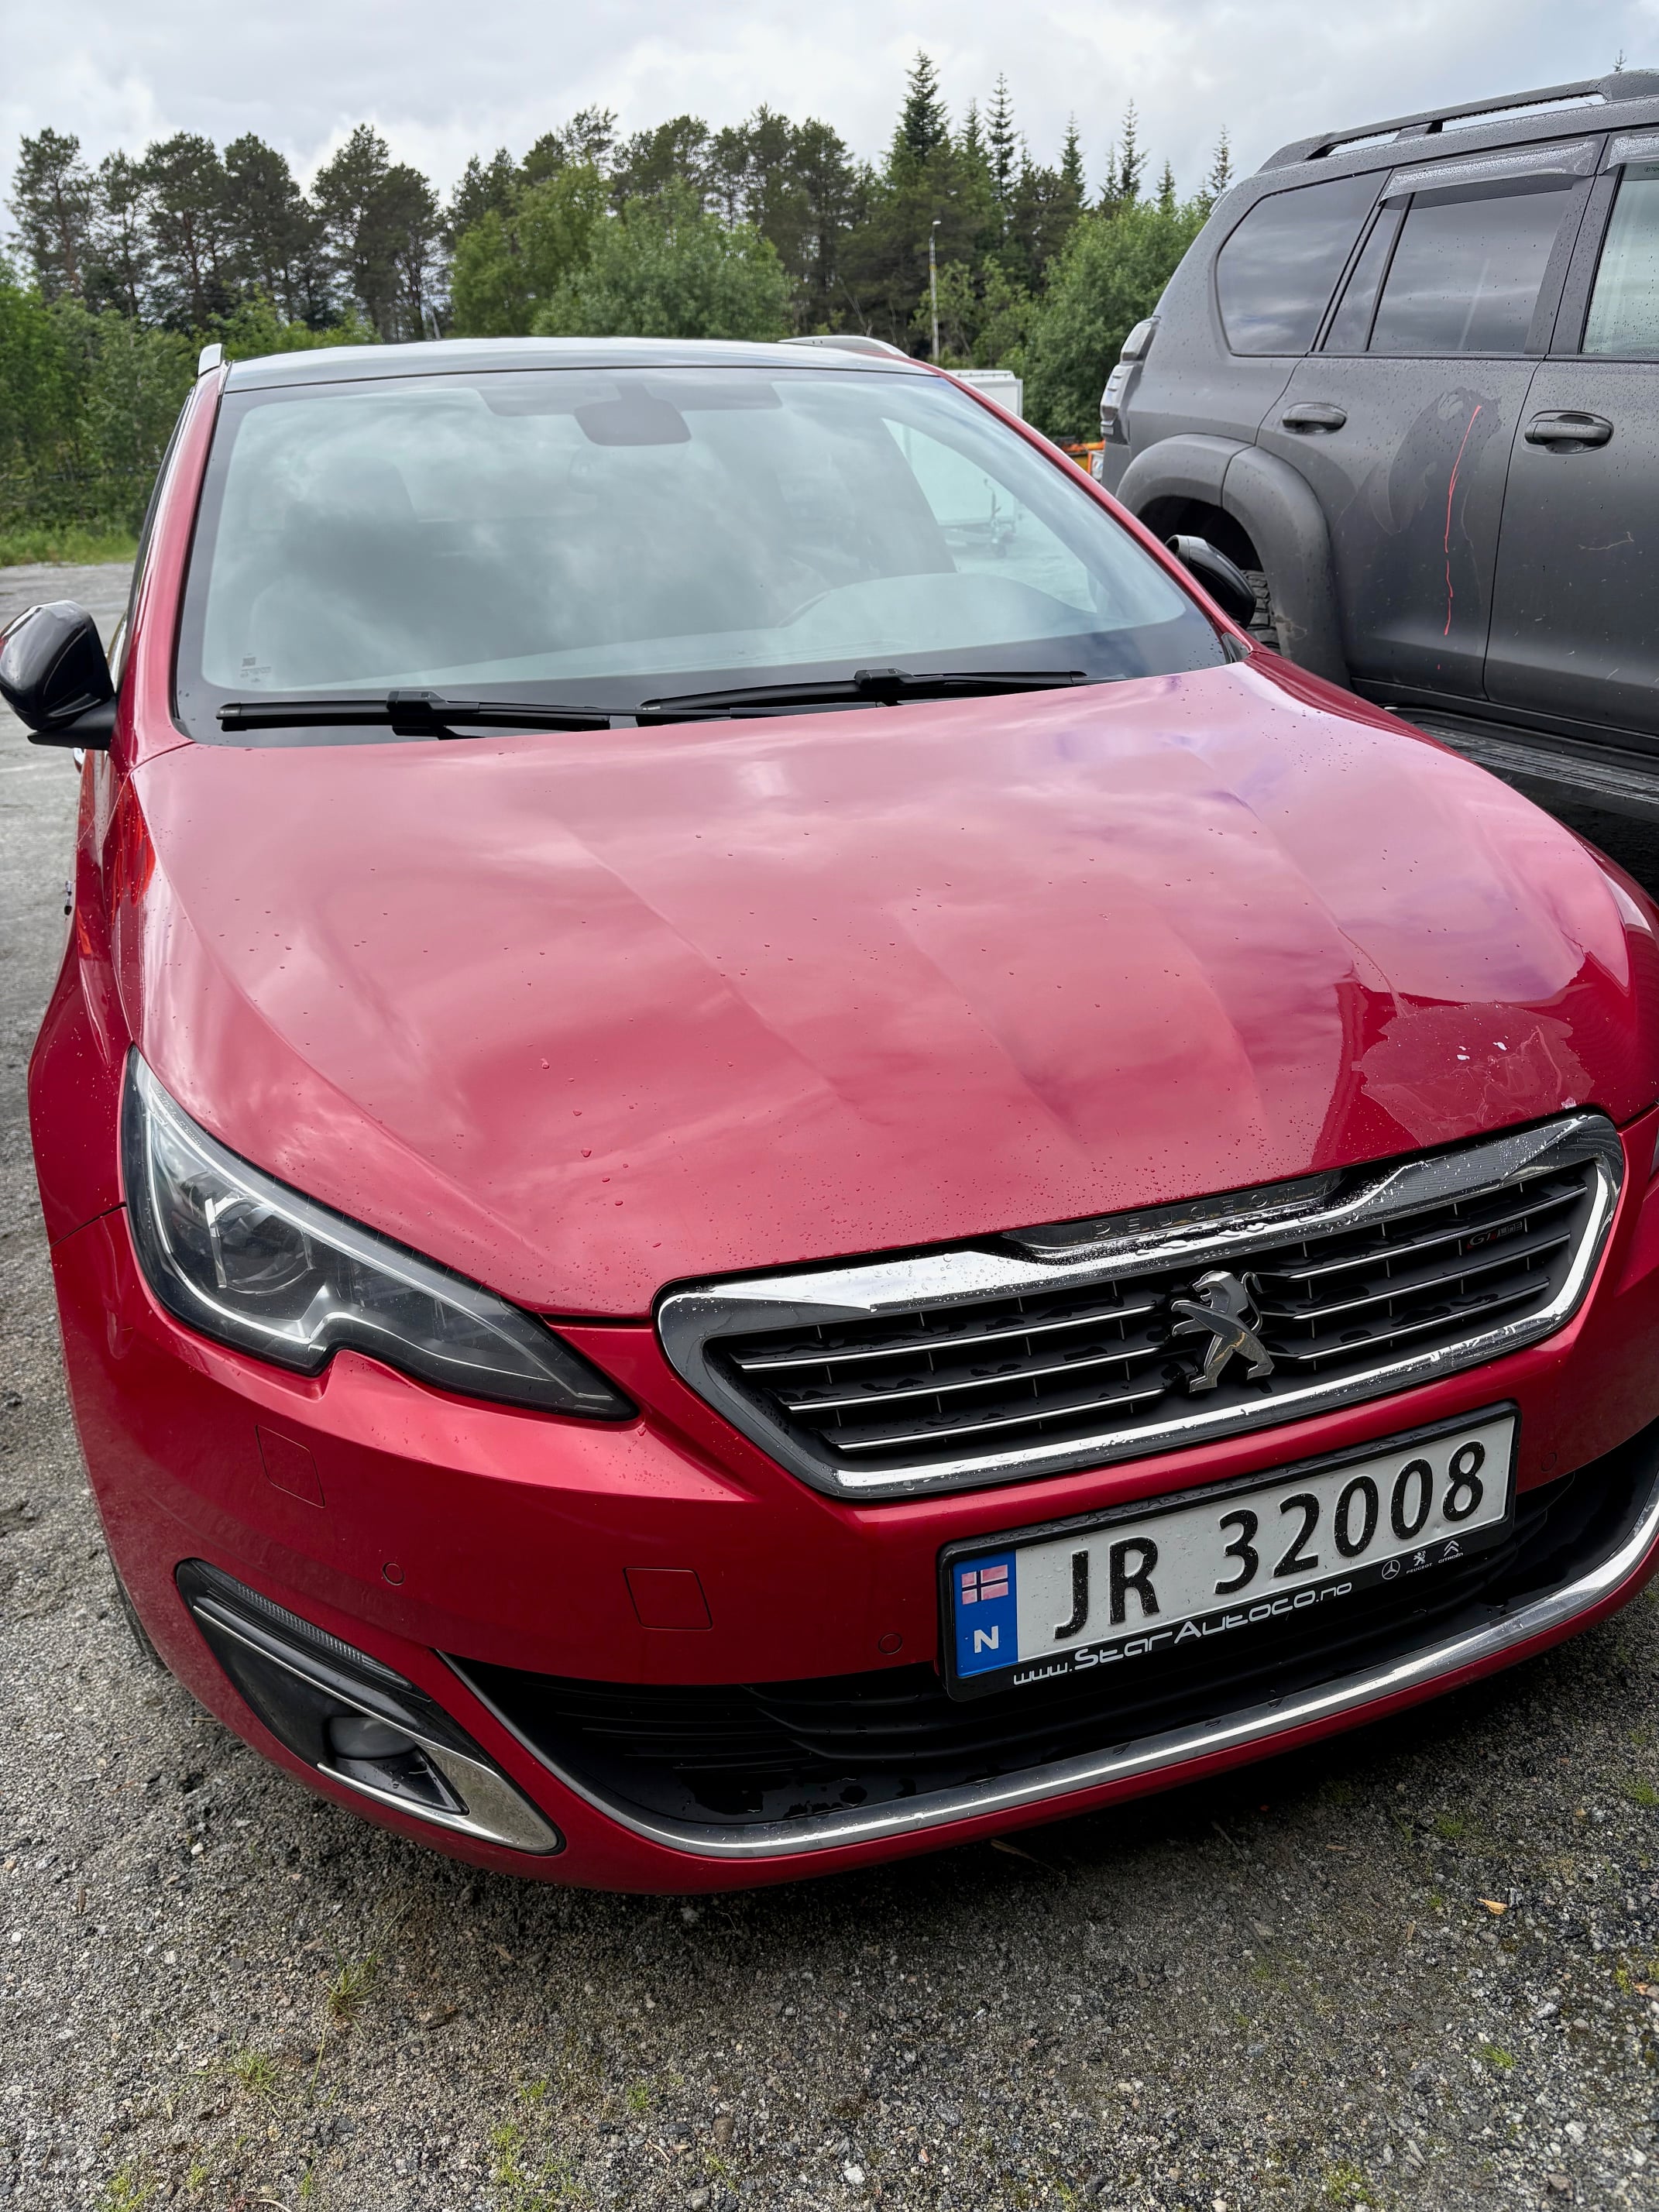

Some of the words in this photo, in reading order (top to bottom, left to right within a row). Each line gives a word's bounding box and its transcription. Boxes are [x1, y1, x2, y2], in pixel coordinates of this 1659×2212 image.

[1087, 1185, 1296, 1236] PEUGEOT
[1054, 1537, 1159, 1640] JR
[1214, 1441, 1485, 1595] 32008
[1406, 1562, 1433, 1574] PEUGEOT
[974, 1626, 999, 1653] N
